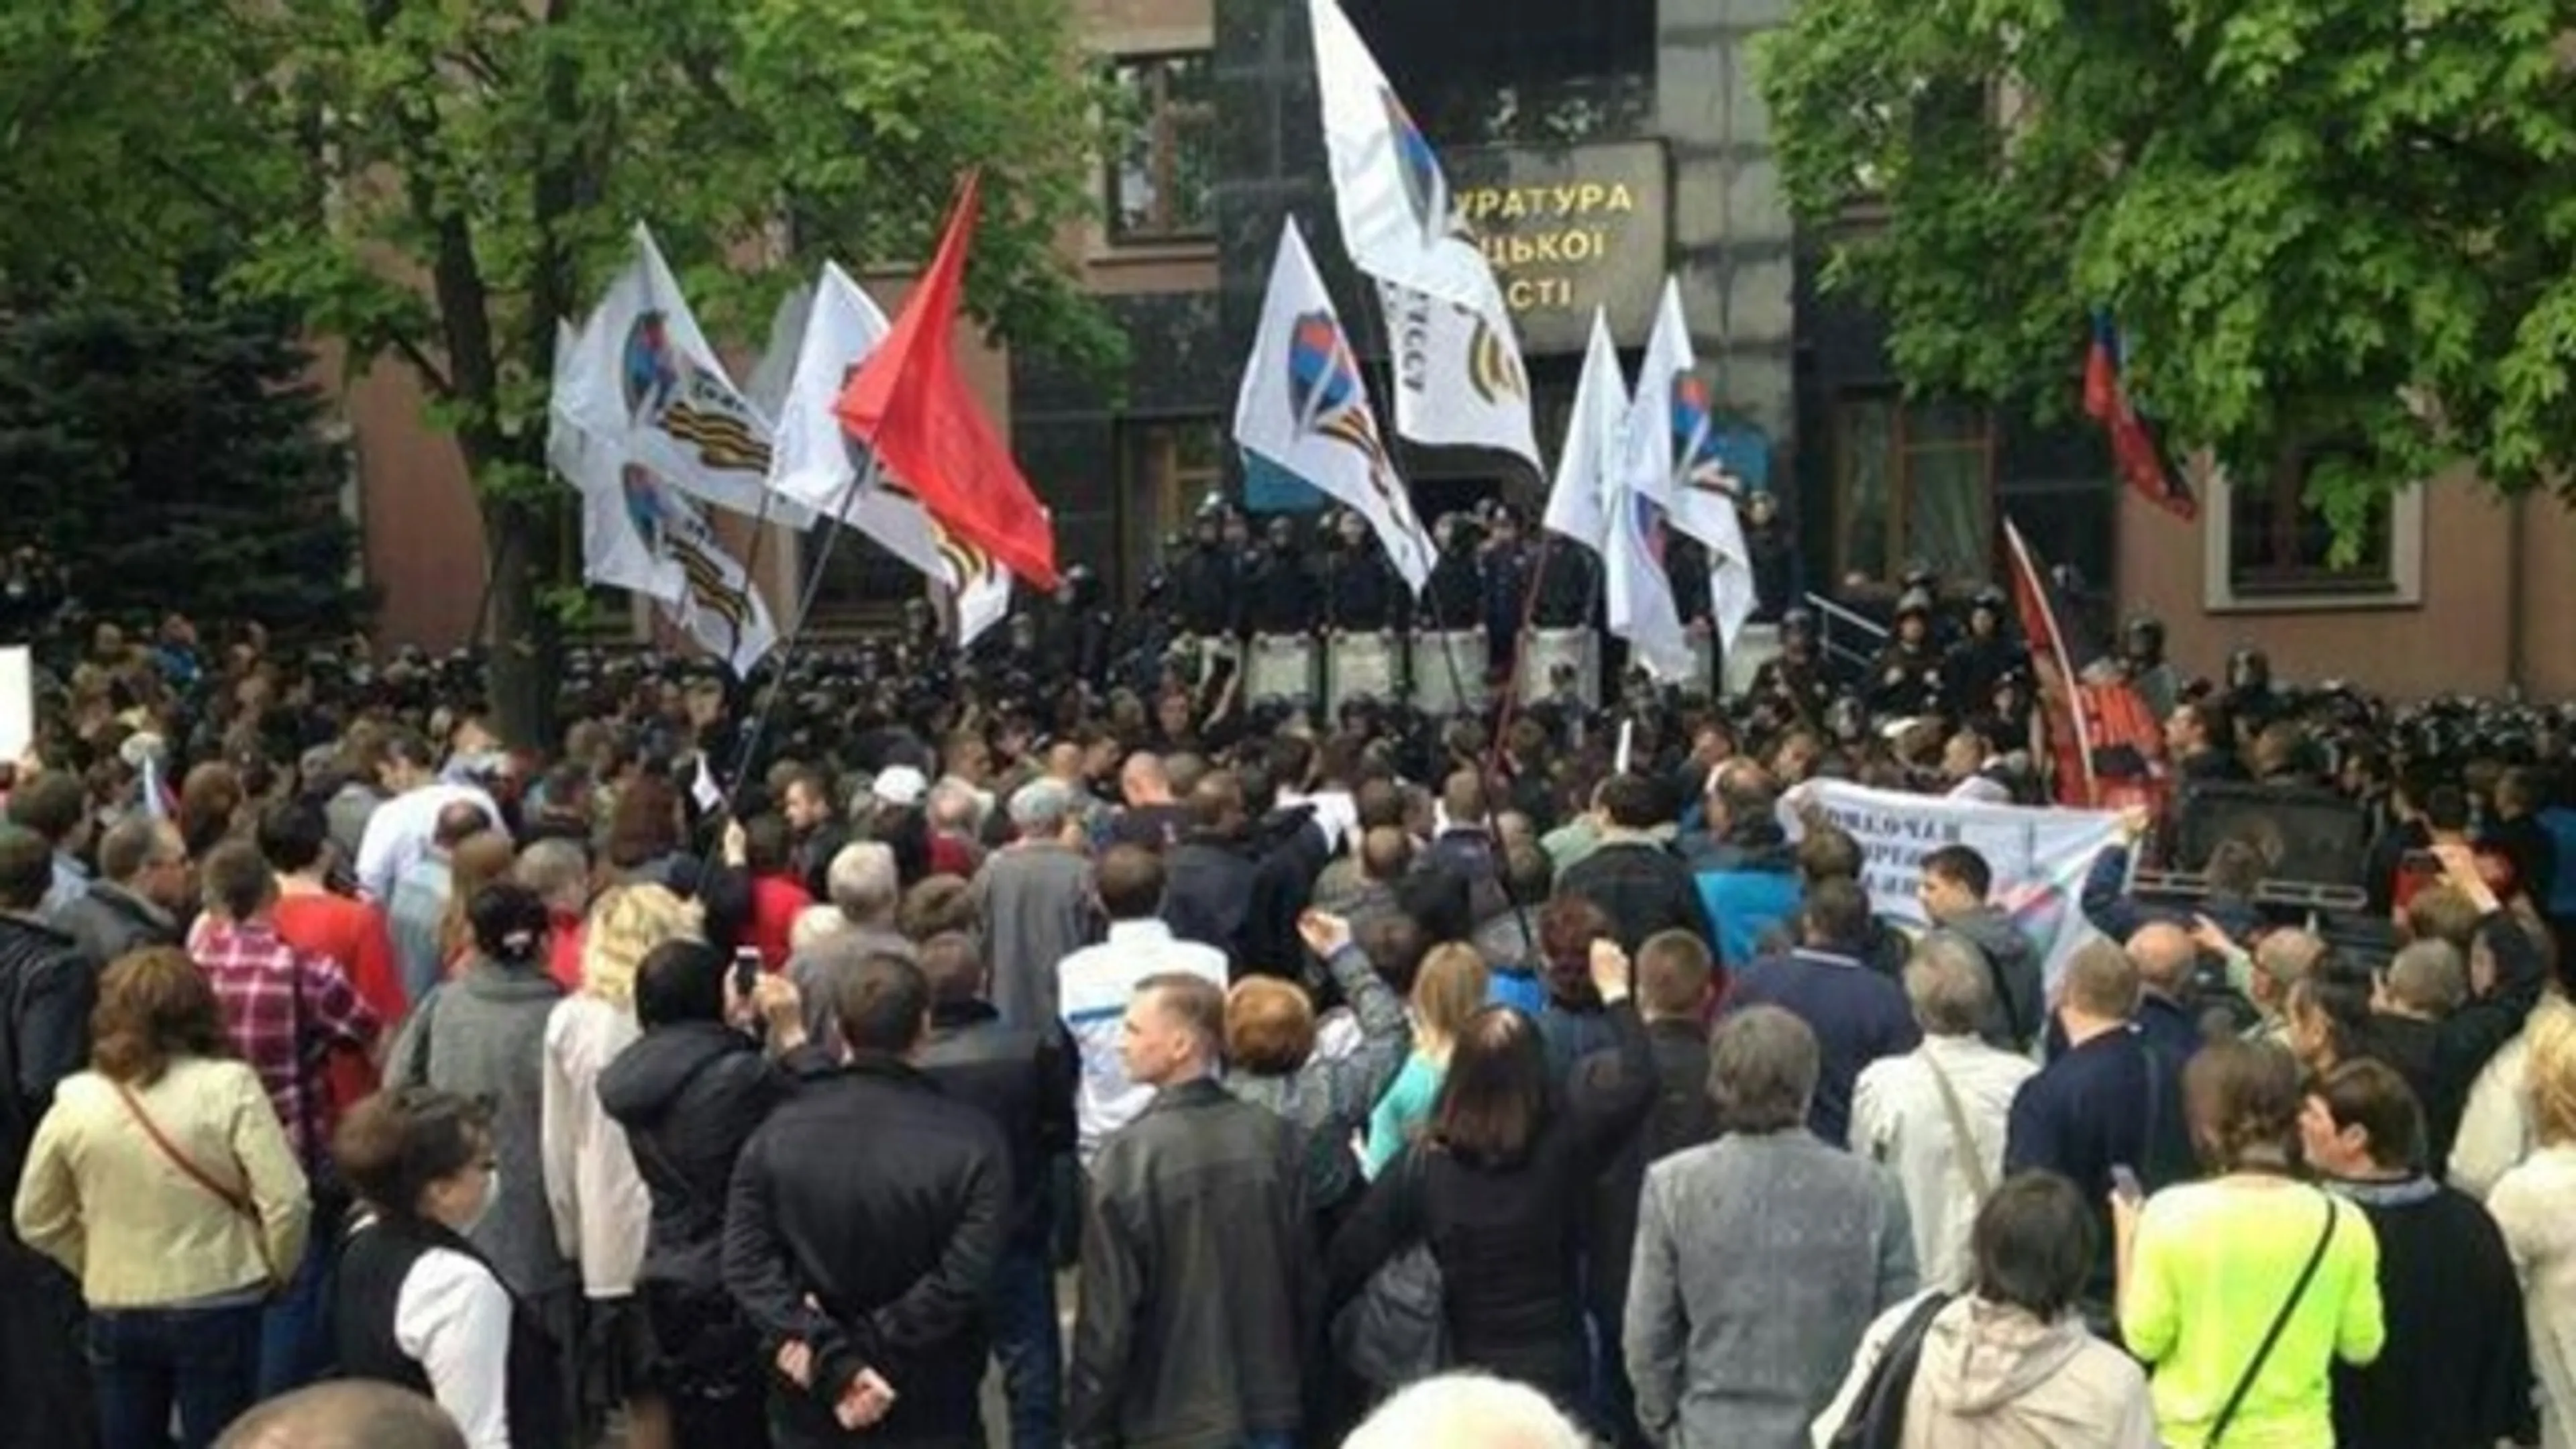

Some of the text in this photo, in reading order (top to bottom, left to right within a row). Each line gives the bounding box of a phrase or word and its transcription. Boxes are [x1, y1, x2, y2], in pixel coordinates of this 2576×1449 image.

[1452, 182, 1633, 219] УРАТУРА
[1479, 223, 1605, 267] ЦЬКОЇ
[1509, 278, 1572, 311] СТІ
